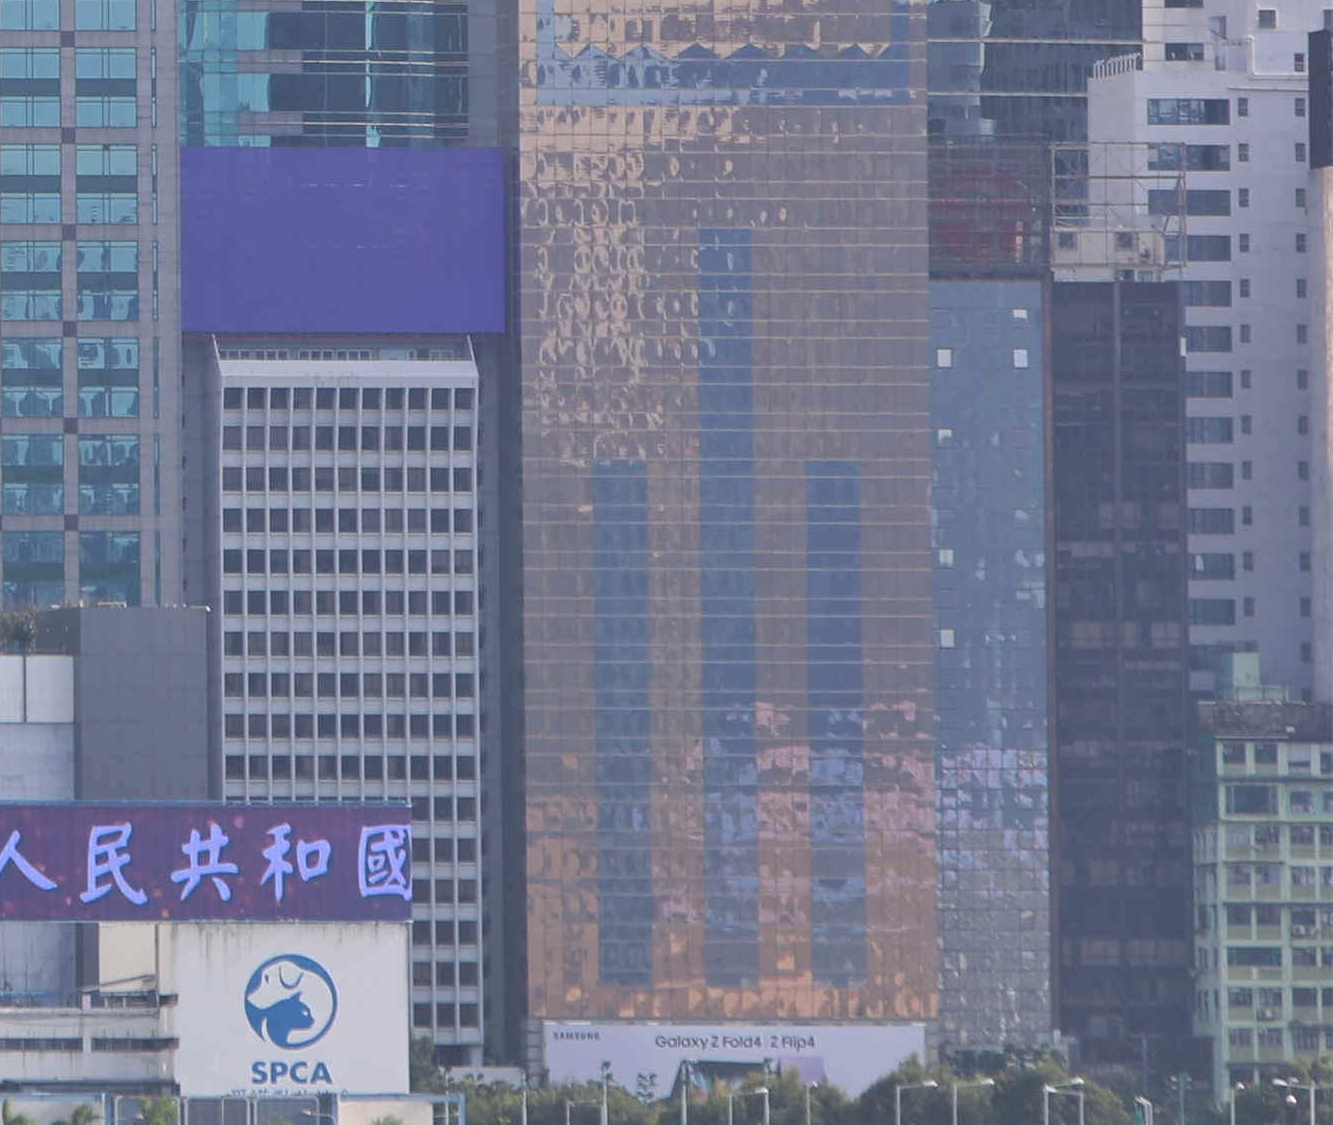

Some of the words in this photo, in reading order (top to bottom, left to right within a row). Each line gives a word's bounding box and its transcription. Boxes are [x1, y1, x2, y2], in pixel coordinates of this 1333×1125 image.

[655, 1035, 708, 1051] Galaxy
[711, 1036, 720, 1049] Z
[723, 1035, 762, 1049] Fold4
[770, 1036, 779, 1049] Z
[782, 1035, 816, 1052] Flip4
[251, 1060, 333, 1085] SPCA
